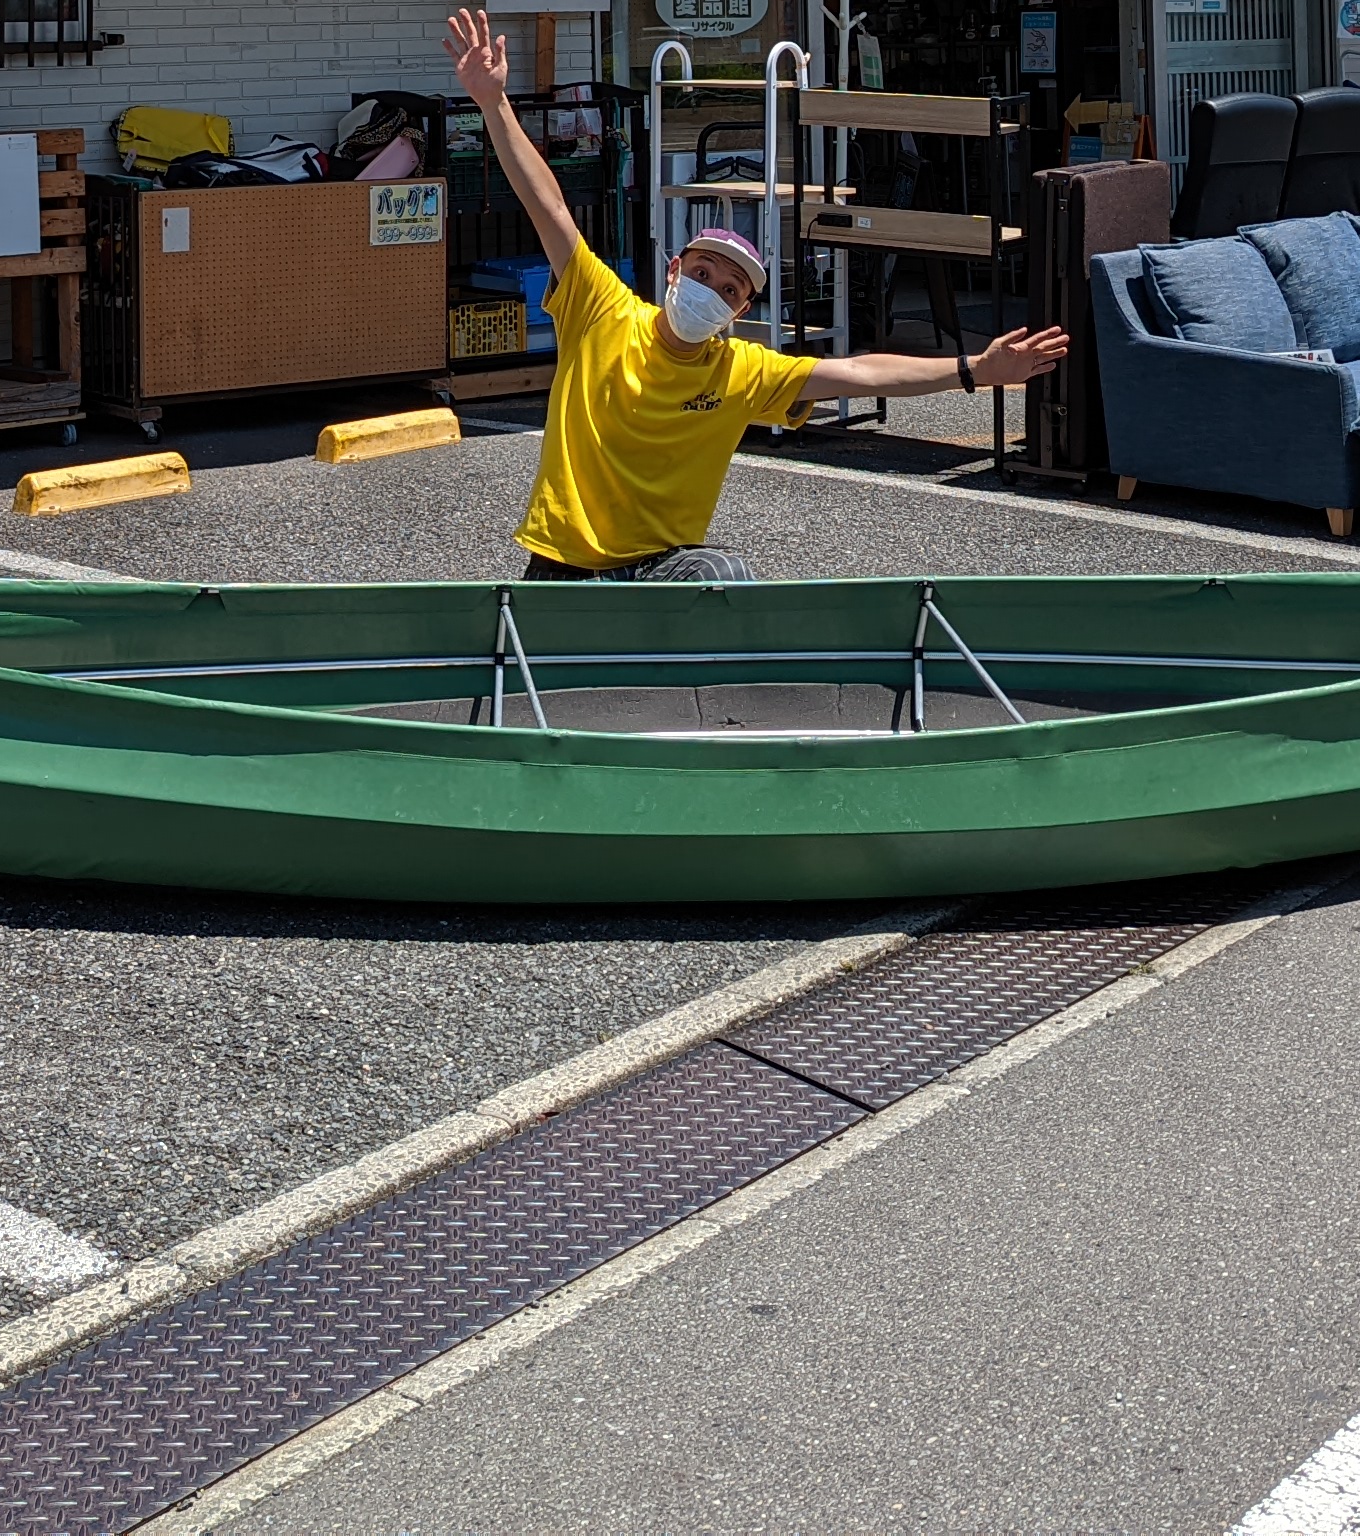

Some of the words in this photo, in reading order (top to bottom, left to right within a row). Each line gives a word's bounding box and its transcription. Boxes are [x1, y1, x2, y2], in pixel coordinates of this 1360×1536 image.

[691, 21, 735, 32] リサイクル
